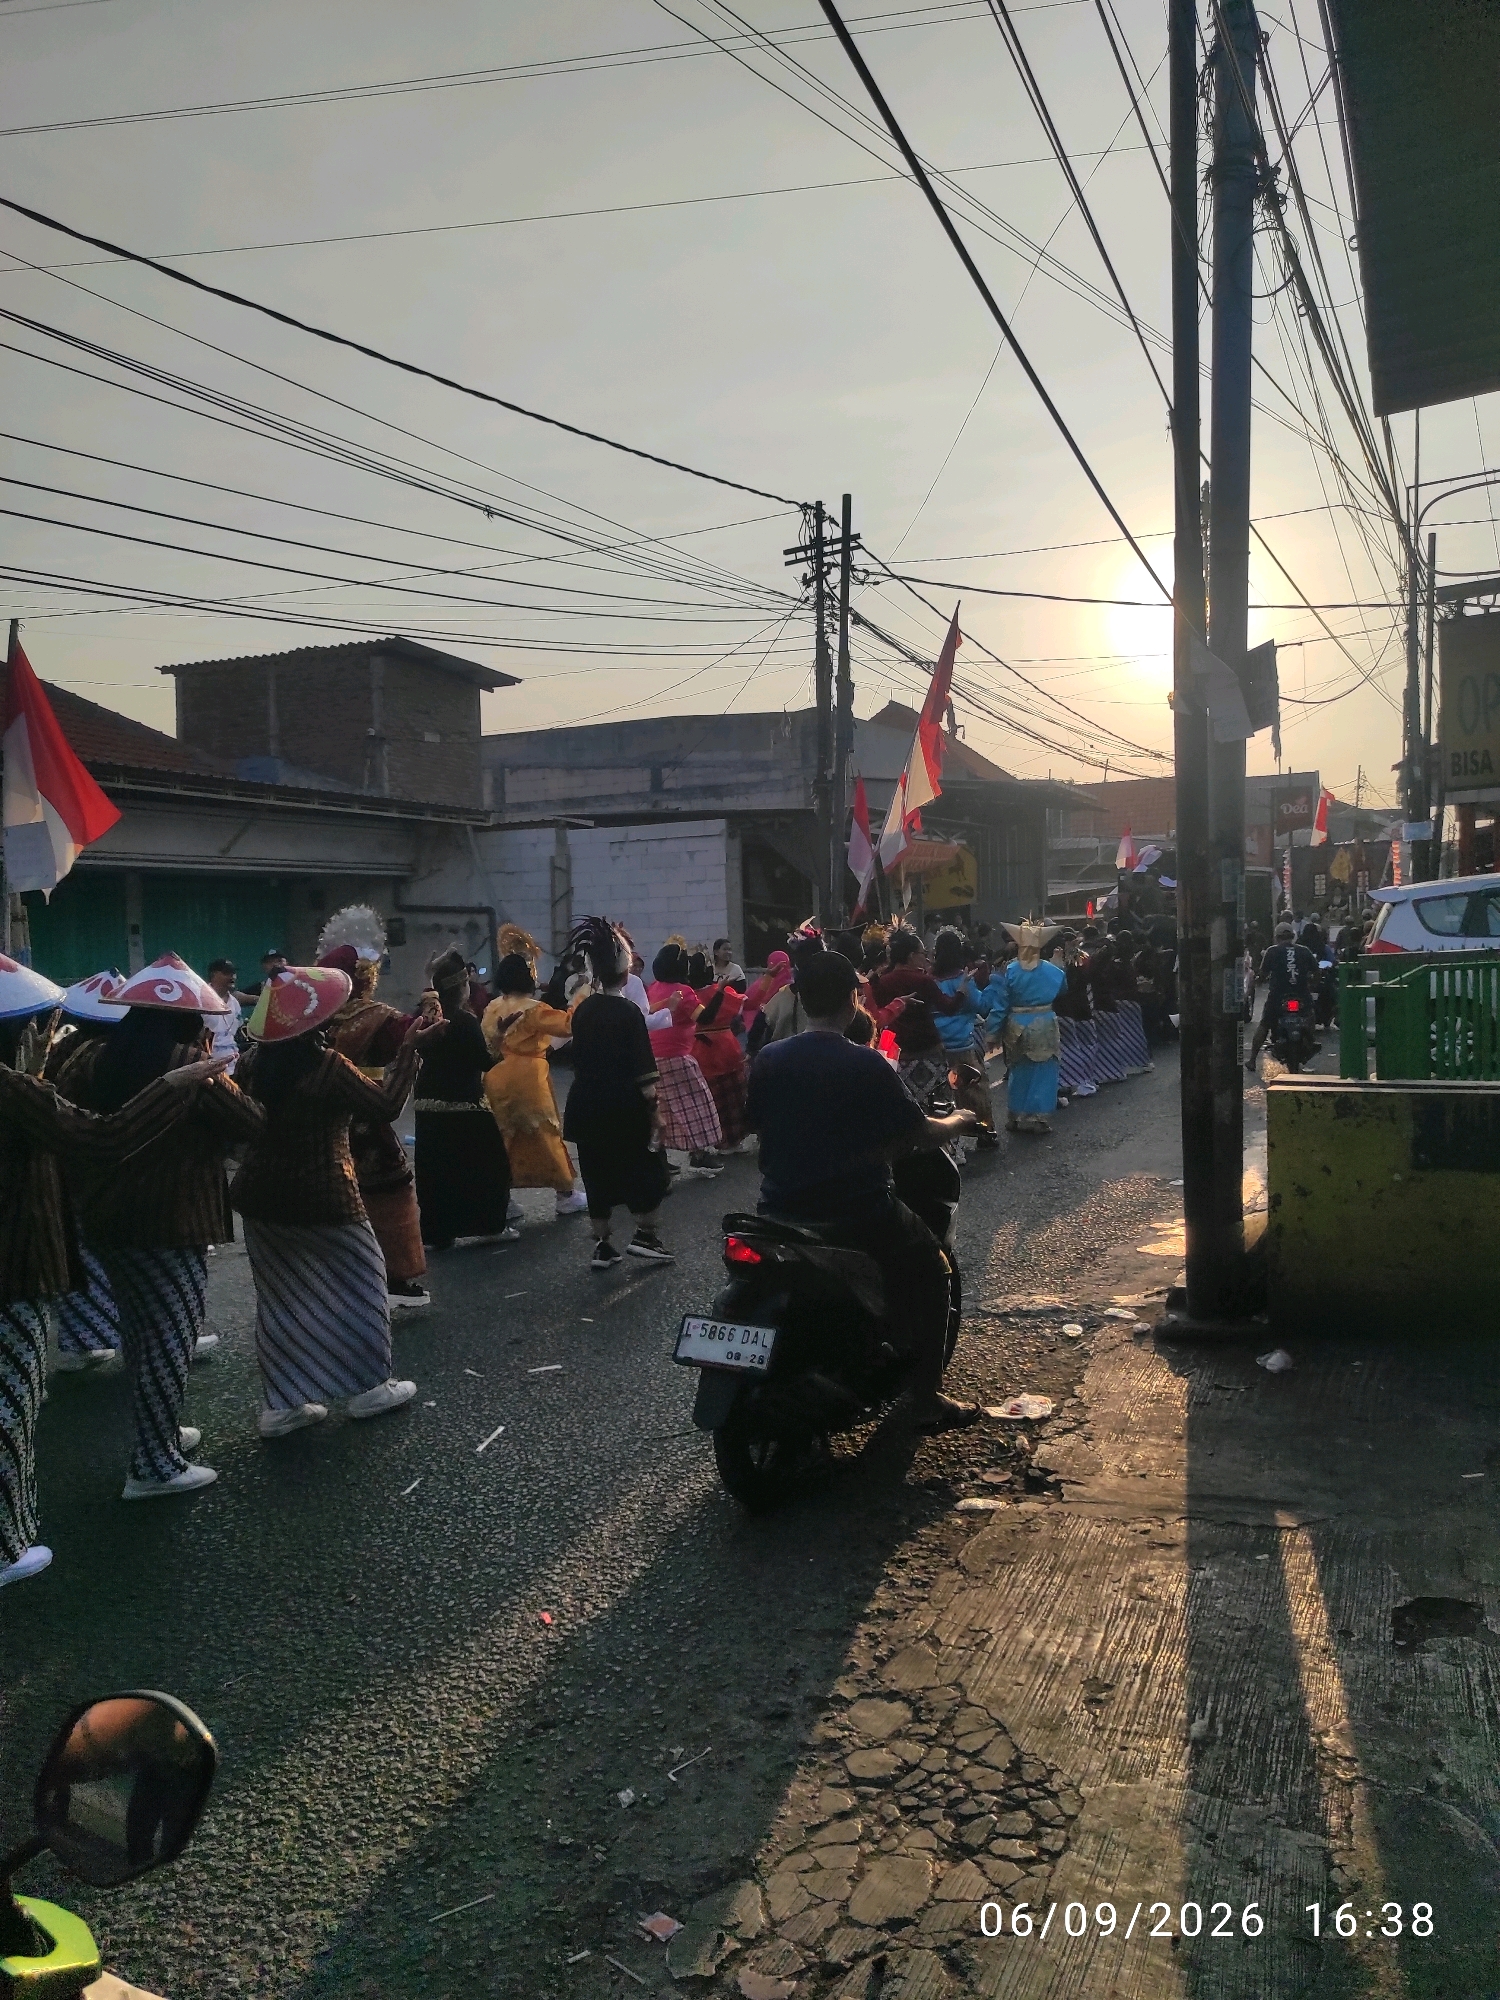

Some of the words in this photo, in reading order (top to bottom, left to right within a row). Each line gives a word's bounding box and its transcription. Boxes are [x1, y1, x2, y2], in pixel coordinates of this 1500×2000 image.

[1451, 750, 1494, 776] BISA
[1279, 802, 1309, 815] Dea
[686, 1321, 692, 1338] L
[699, 1322, 737, 1343] 5866
[741, 1329, 768, 1349] DAL
